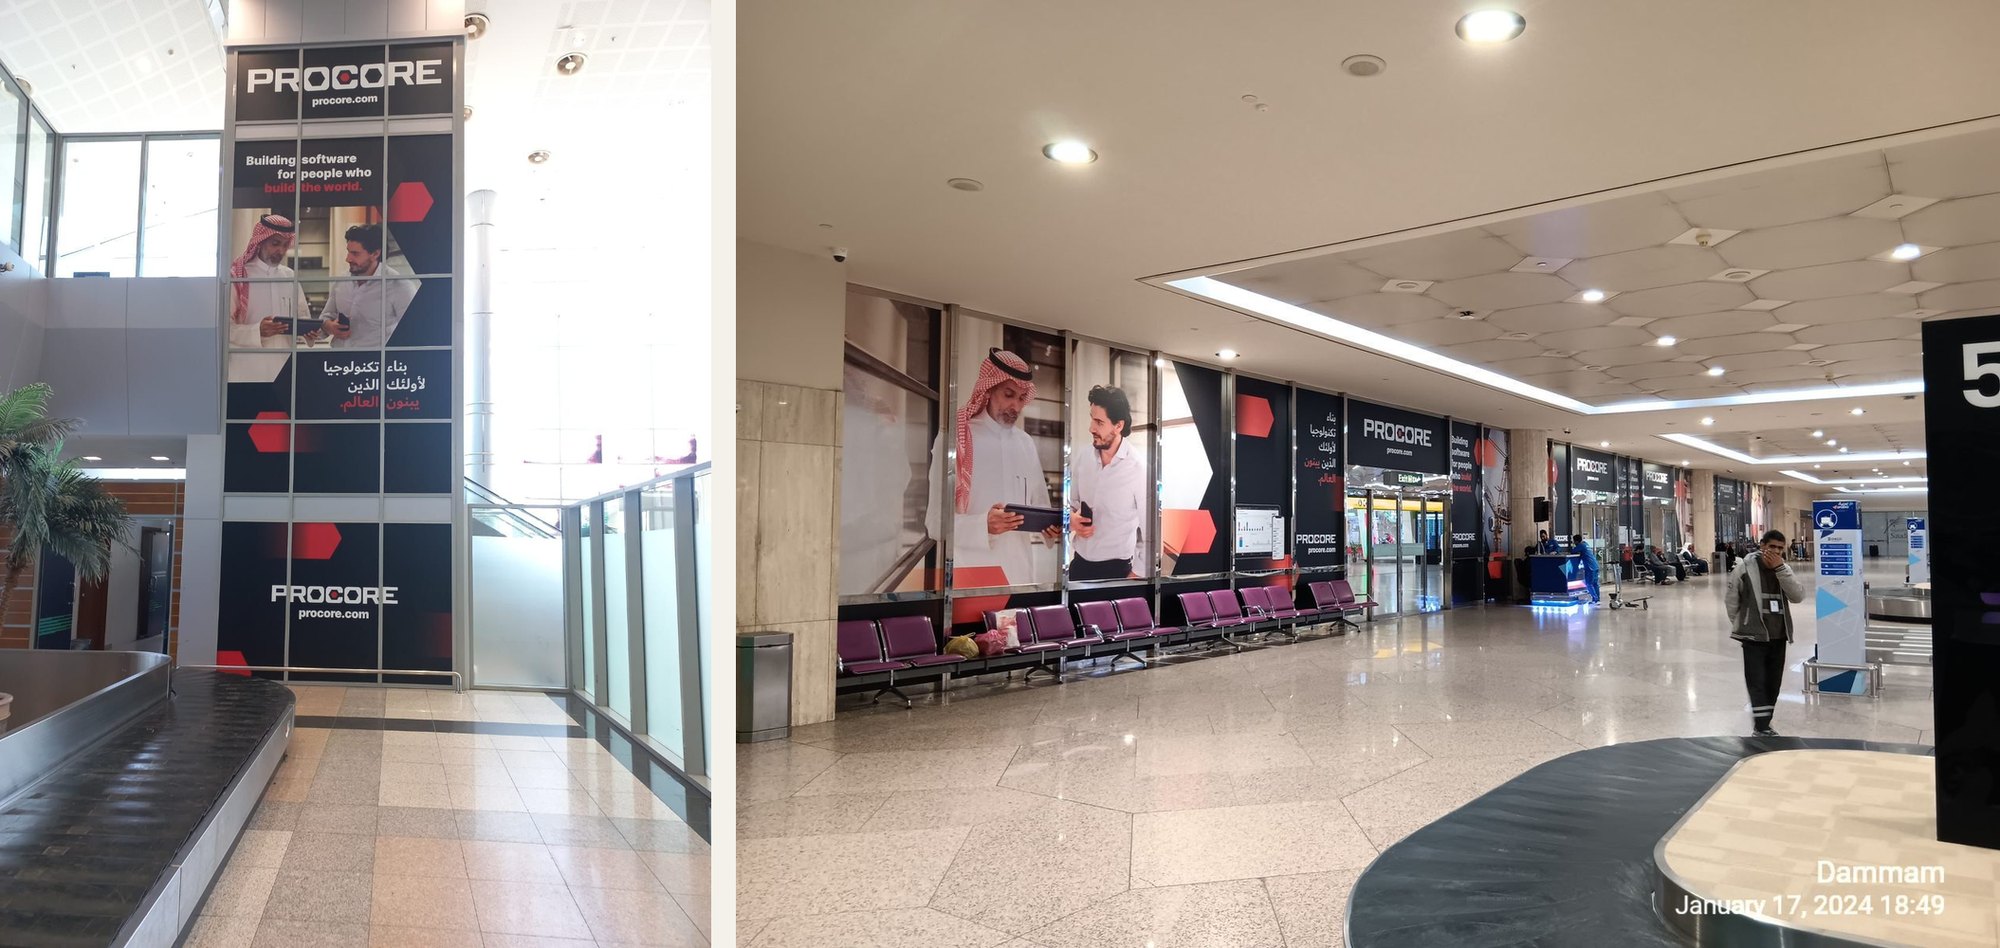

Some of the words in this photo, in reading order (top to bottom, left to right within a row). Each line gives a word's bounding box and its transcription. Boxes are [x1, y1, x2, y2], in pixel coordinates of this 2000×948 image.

[247, 59, 442, 93] PROCORE
[312, 95, 378, 107] procore.com
[246, 155, 296, 168] Building
[301, 153, 357, 165] software
[277, 169, 296, 180] for
[301, 168, 343, 181] people
[345, 168, 372, 178] who
[264, 182, 296, 193] build
[301, 182, 321, 192] the
[324, 181, 363, 192] world.
[323, 360, 380, 375] تكنولوجيا
[387, 361, 408, 374] بناء
[1962, 341, 2000, 408] 5
[347, 378, 380, 393] الذين
[386, 377, 426, 392] لأولئك
[340, 396, 379, 413] العالم.
[386, 397, 420, 410] يبنون
[1326, 412, 1336, 425] بناء
[1309, 424, 1336, 438] تكنولوجيا
[1363, 418, 1432, 447] PROCORE
[1318, 442, 1336, 455] لأولئك
[1386, 447, 1413, 457] procore.com
[1321, 458, 1336, 470] الذين
[1576, 457, 1608, 475] PROCORE
[1646, 470, 1669, 484] PROCORE
[1296, 534, 1337, 544] PROCORE
[1308, 546, 1337, 555] procore.com
[271, 584, 399, 605] PROCORE
[298, 607, 370, 620] procore.com
